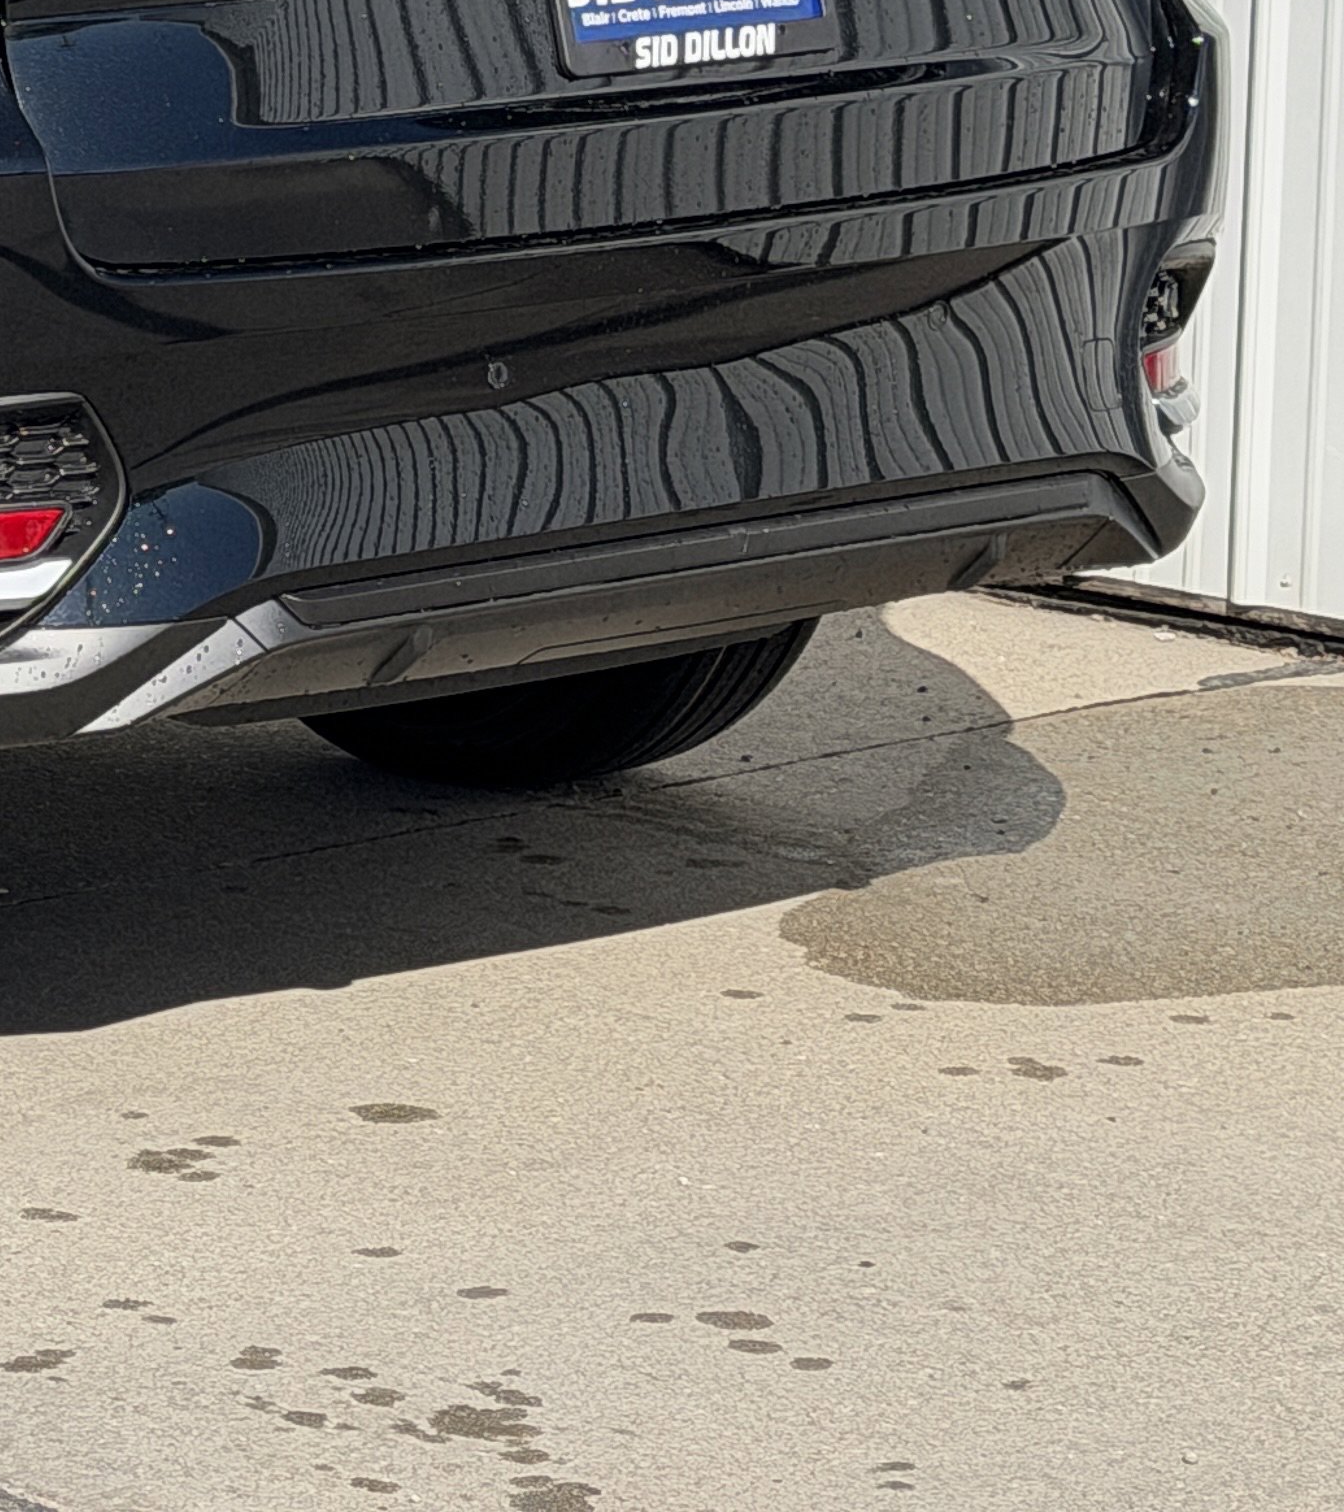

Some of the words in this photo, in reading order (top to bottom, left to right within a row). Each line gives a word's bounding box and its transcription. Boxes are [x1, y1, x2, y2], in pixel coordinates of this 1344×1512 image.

[582, 11, 610, 26] Blair
[618, 7, 651, 23] Crete
[658, 2, 707, 19] Fremont
[635, 33, 678, 69] SID
[684, 23, 776, 63] DILLON
